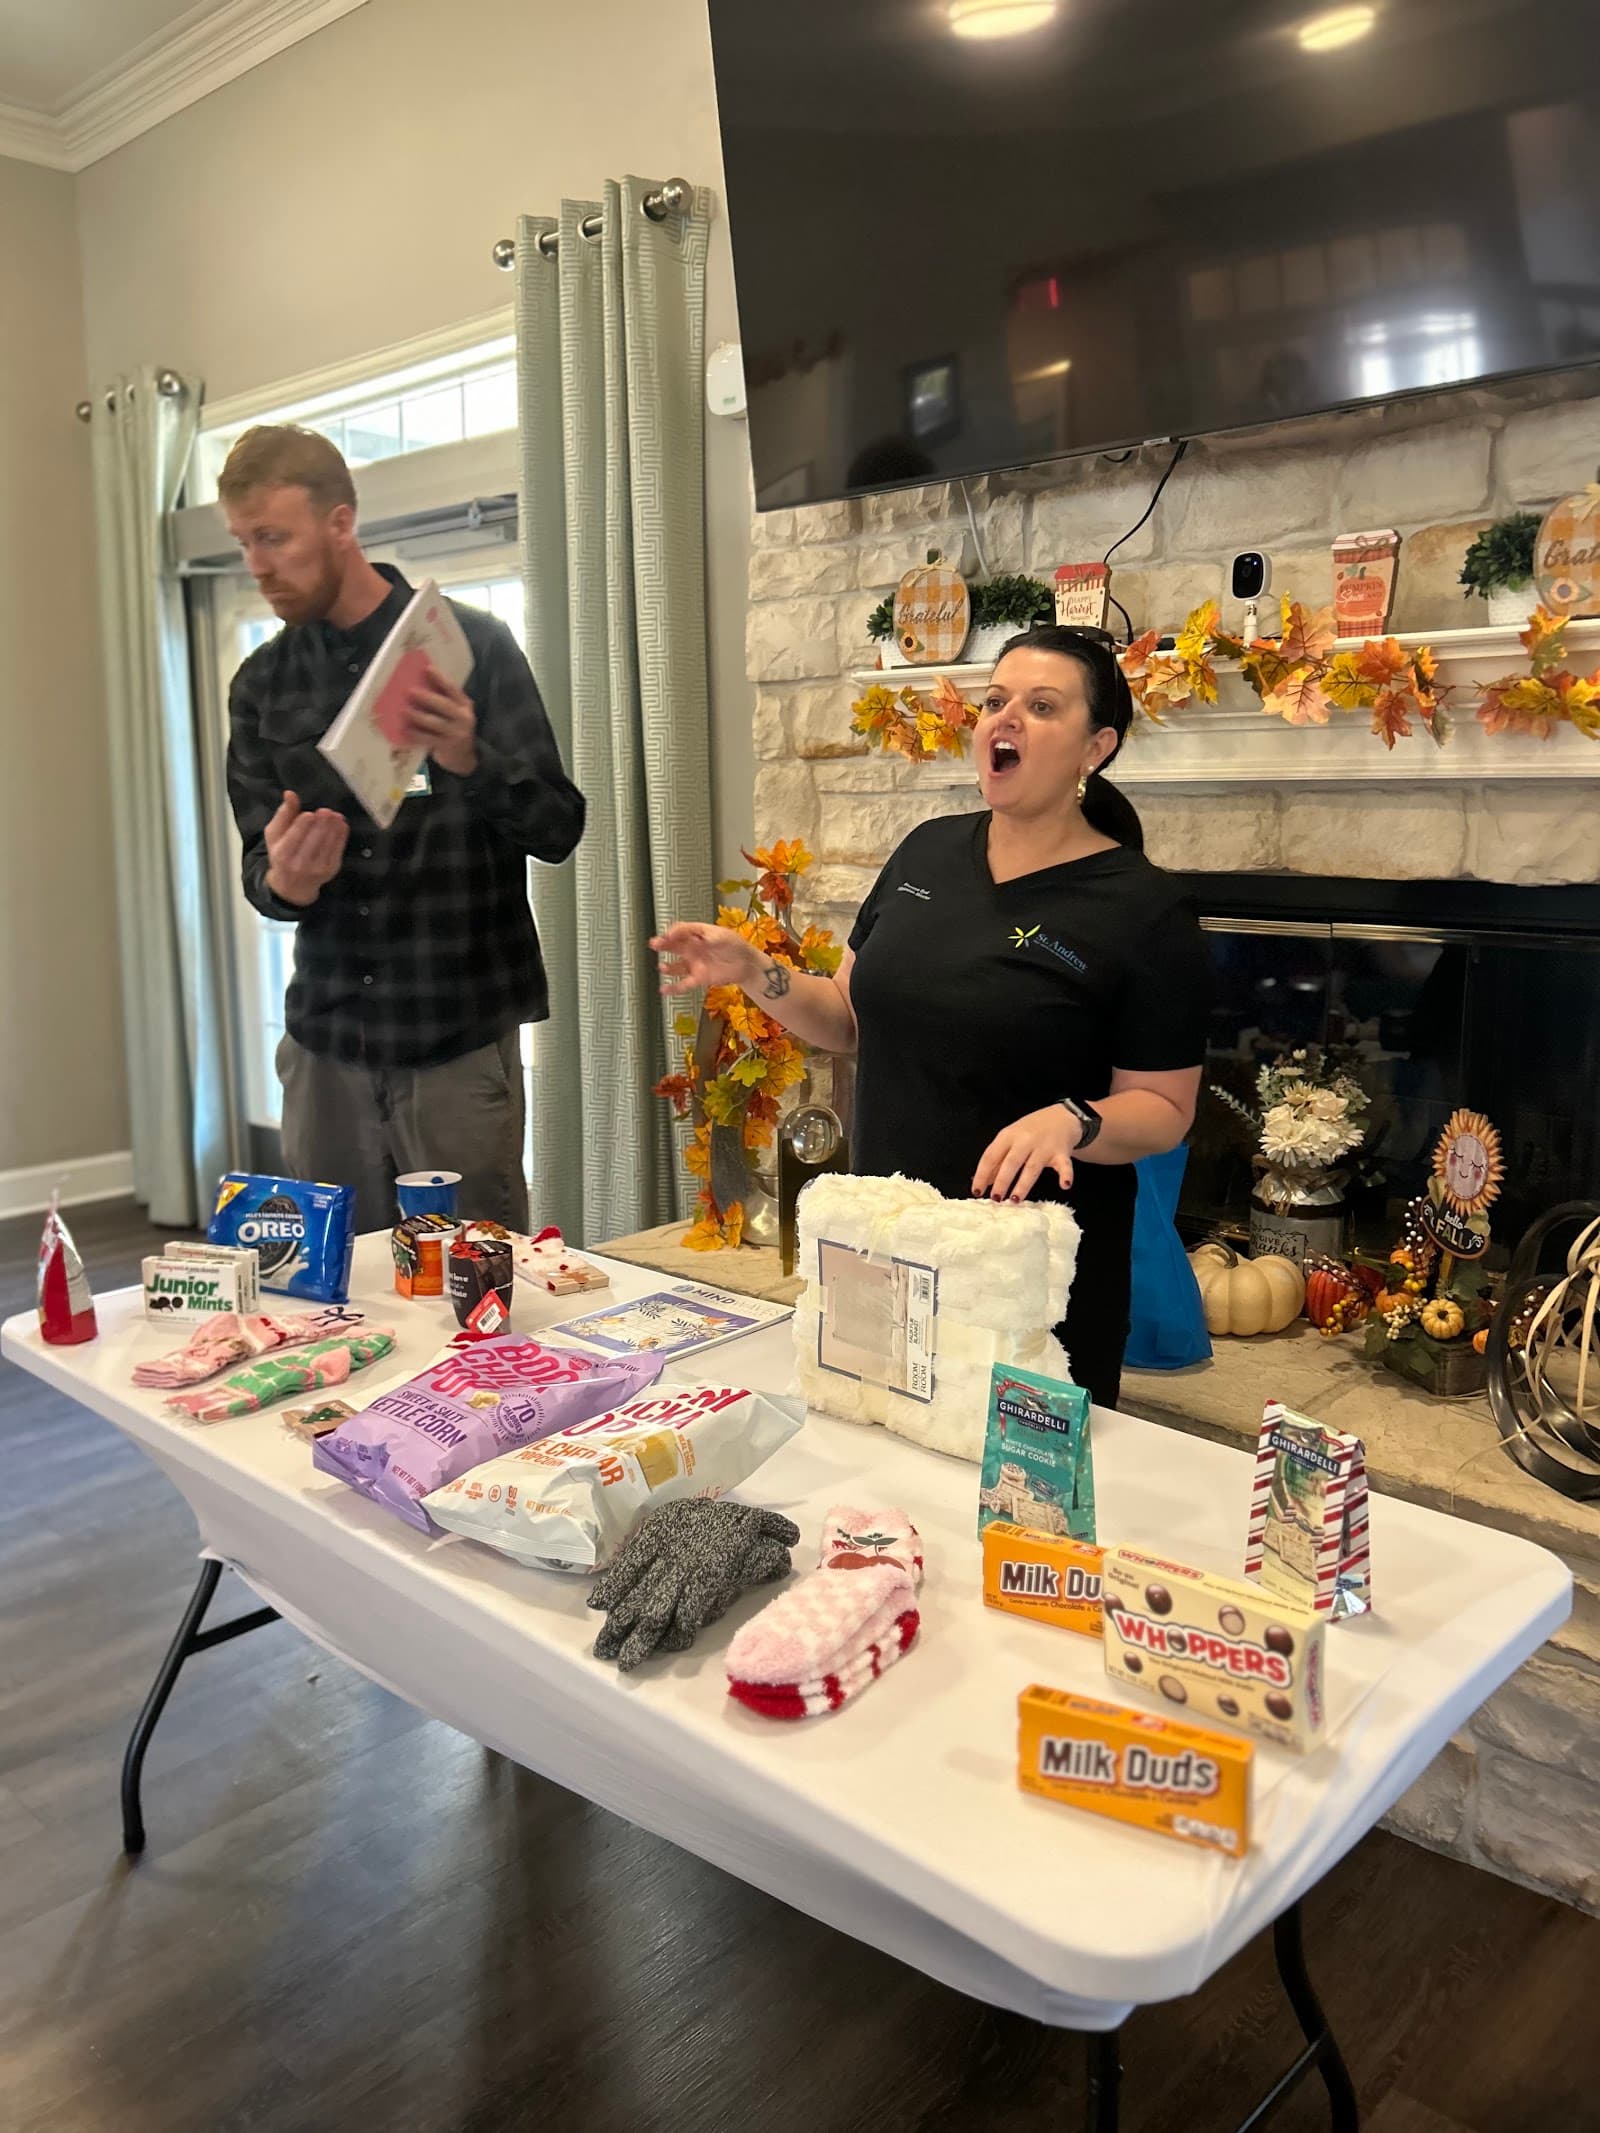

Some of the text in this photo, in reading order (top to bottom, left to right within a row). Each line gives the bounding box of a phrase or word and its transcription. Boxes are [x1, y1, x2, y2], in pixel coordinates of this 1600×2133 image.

[1543, 537, 1600, 568] Grat
[898, 598, 964, 625] Grateful
[1061, 598, 1097, 617] Harvest
[1049, 940, 1088, 970] Andrew
[238, 1221, 305, 1243] OREO
[1435, 1218, 1465, 1250] FALL
[1444, 1210, 1463, 1230] hello
[146, 1273, 219, 1296] Junior
[692, 1288, 736, 1304] MIND
[187, 1296, 233, 1312] Mints
[494, 1342, 579, 1386] BOO
[397, 1390, 432, 1405] SWEET
[434, 1406, 468, 1423] SALTY
[512, 1399, 536, 1423] 70
[999, 1401, 1067, 1431] GHIRARDELLI
[414, 1414, 467, 1448] CORN
[1001, 1442, 1056, 1467] SUGAR COOKIE
[1271, 1435, 1338, 1473] GHIRARDELLI
[1001, 1561, 1102, 1600] Milk Du
[1114, 1612, 1288, 1684] WHOPPERS
[1041, 1737, 1215, 1790] Milk Duds
